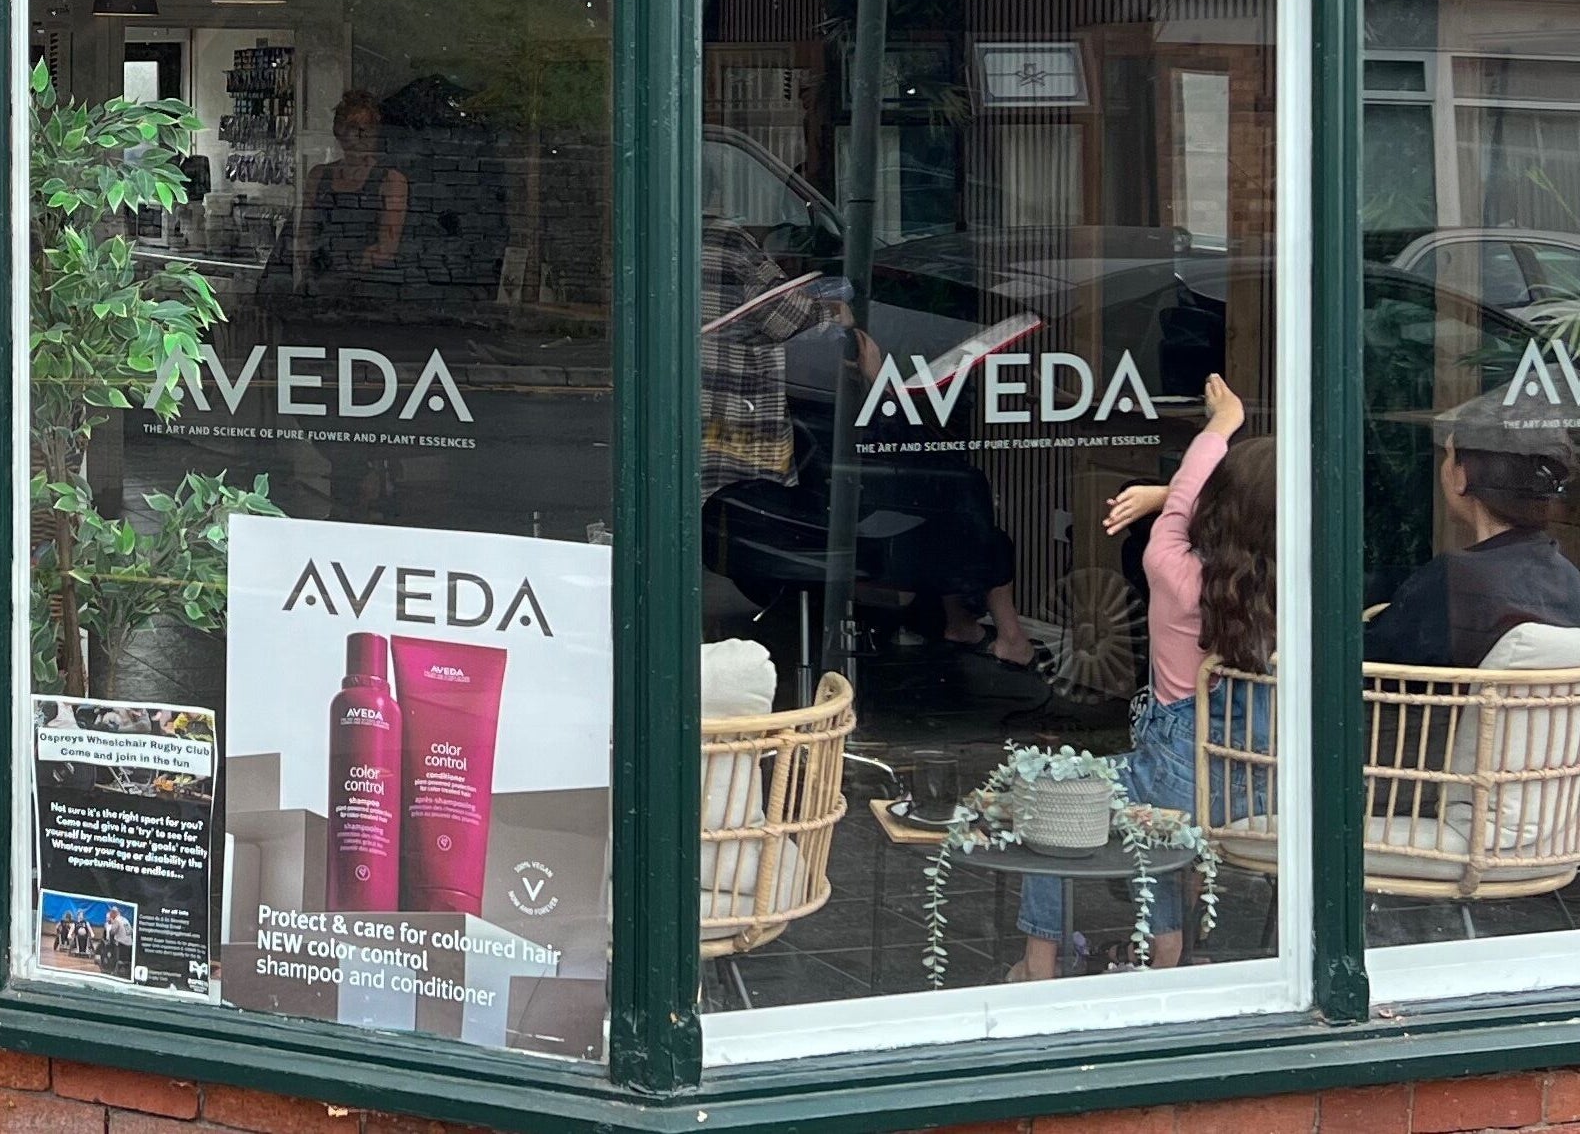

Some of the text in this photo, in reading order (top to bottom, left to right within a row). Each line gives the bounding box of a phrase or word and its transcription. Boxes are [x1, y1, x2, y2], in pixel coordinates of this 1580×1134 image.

[143, 345, 474, 421] AVEDA
[854, 349, 1158, 428] AVEDA
[143, 424, 162, 433] THE
[166, 425, 185, 434] ART
[188, 426, 210, 435] AND
[213, 426, 256, 437] SCIENCE
[277, 429, 304, 439] PURE
[308, 431, 350, 441] FLOWER
[353, 432, 376, 442] AND
[380, 434, 416, 444] PLANT
[420, 436, 476, 448] ESSENCES
[856, 435, 1160, 453] THE ART AND SCIENCE OF PURE FLOWER AND PLANT ESSENCES
[282, 558, 554, 637] AVEDA
[431, 666, 463, 676] AVEDA
[347, 708, 383, 720] AVEDA
[40, 733, 210, 756] Ospreys Wheelchair Rugby Club
[431, 742, 462, 756] color
[60, 748, 189, 768] Come and join in the fun
[425, 755, 467, 771] control
[350, 764, 380, 780] color
[345, 780, 384, 795] control
[50, 802, 203, 830] Not sure it's the right sport for you?
[56, 815, 81, 827] Come
[82, 820, 99, 830] and
[101, 821, 119, 832] give
[120, 823, 126, 833] it
[136, 826, 154, 838] 'try'
[156, 829, 165, 838] to
[167, 832, 182, 840] see
[184, 831, 198, 842] for
[45, 828, 207, 859] yourself by making your 'goals' reality
[52, 838, 93, 853] Whatever
[95, 847, 115, 856] your
[117, 850, 131, 860] age
[145, 852, 186, 868] disability
[188, 858, 202, 868] the
[68, 856, 124, 871] opportunities
[125, 865, 139, 874] are
[532, 860, 554, 878] VEGAN
[508, 890, 558, 915] NOW AND FOREVER
[258, 904, 562, 965] Protect & care for coloured hair
[257, 930, 428, 971] NEW color control
[256, 956, 496, 1006] shampoo and conditioner
